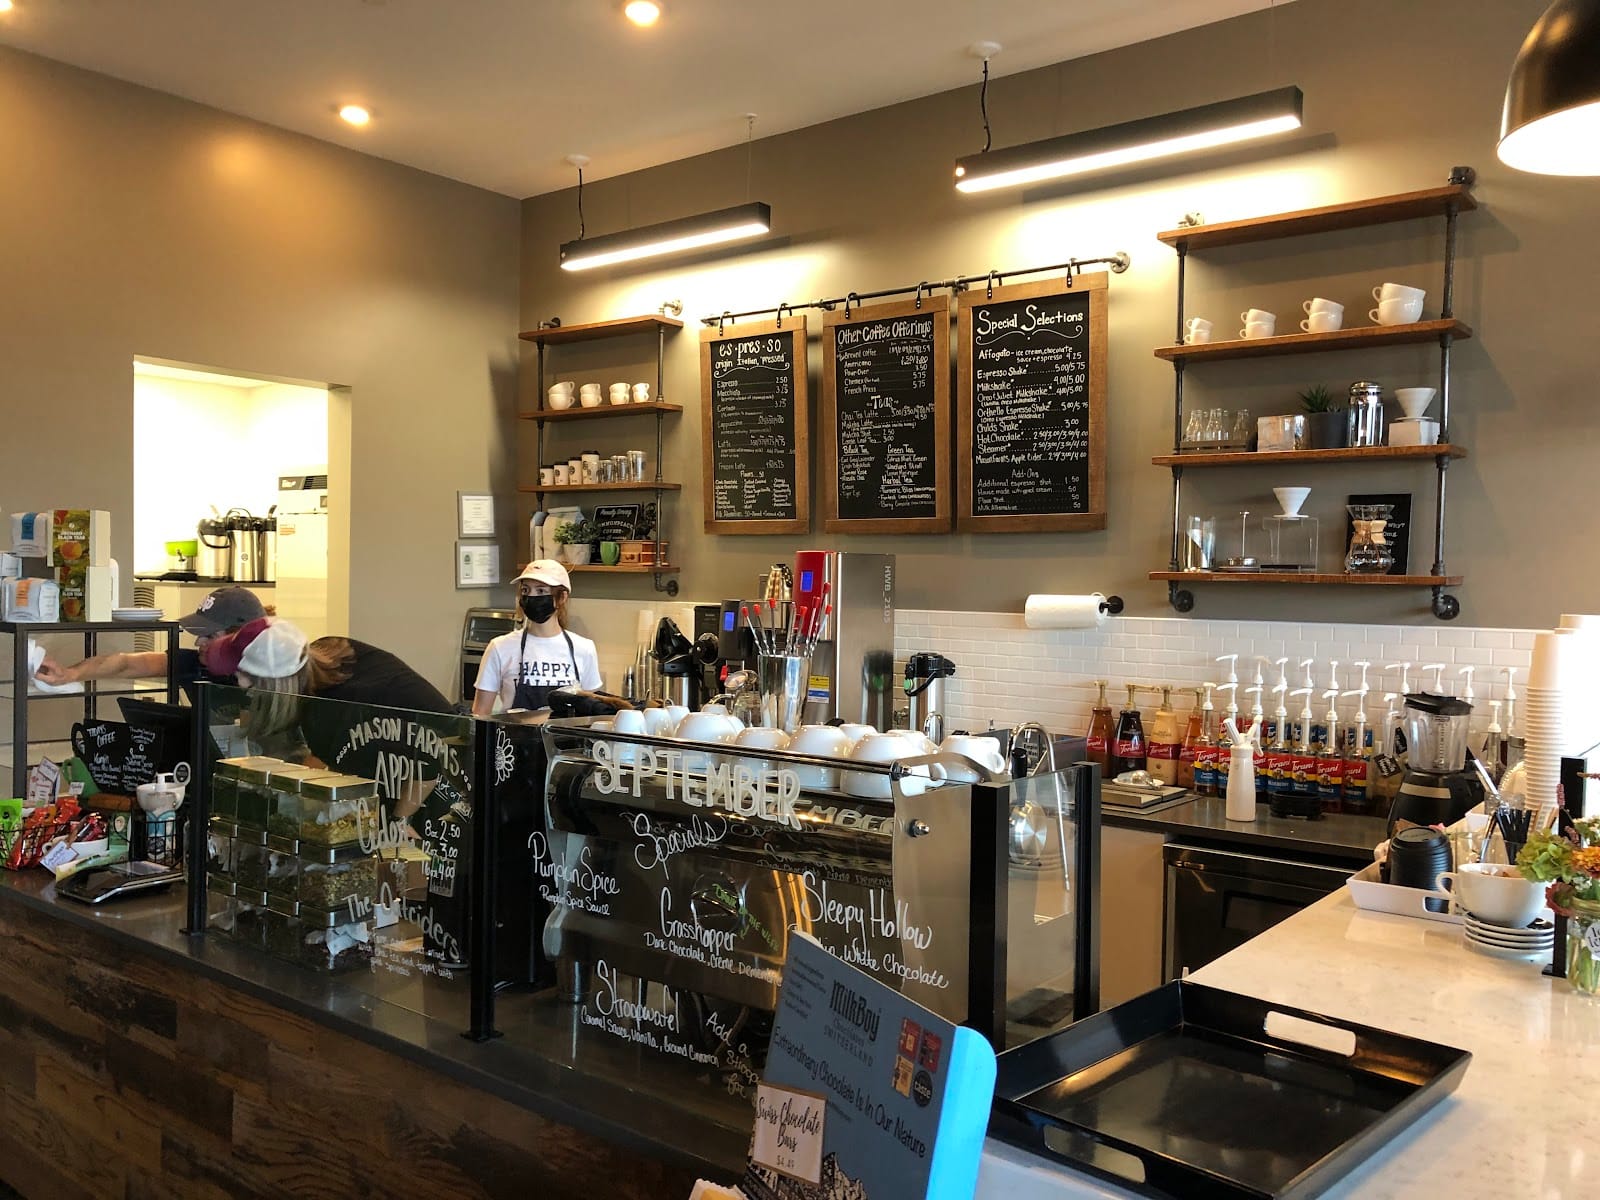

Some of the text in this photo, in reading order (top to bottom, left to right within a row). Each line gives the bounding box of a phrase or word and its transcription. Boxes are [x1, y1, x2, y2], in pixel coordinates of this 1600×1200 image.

[838, 320, 932, 344] Other Coffee Offerings
[976, 304, 1084, 335] Special Selections
[715, 360, 733, 372] origin
[518, 662, 572, 676] HAPPY
[350, 716, 460, 777] MASON FARMS
[1267, 758, 1291, 770] Torani
[1291, 760, 1314, 771] Torani
[1316, 763, 1340, 774] Torani
[592, 740, 802, 831] SEPTEMBER
[440, 820, 461, 842] 2.50
[634, 812, 727, 880] Specials
[528, 831, 620, 900] Pumpkin Spice
[342, 894, 372, 922] The
[660, 886, 738, 956] Grasshopper
[801, 871, 932, 953] Sleepy Hollow
[882, 954, 949, 990] Chocolate
[706, 1011, 750, 1058] Add a
[774, 1026, 818, 1080] Extraordinary
[820, 1060, 854, 1104] Chocolate
[874, 1104, 894, 1132] Our
[894, 1116, 926, 1158] Nature
[756, 1096, 778, 1125] Swiss
[780, 1098, 820, 1136] Chocolate
[777, 1123, 798, 1152] Bars
